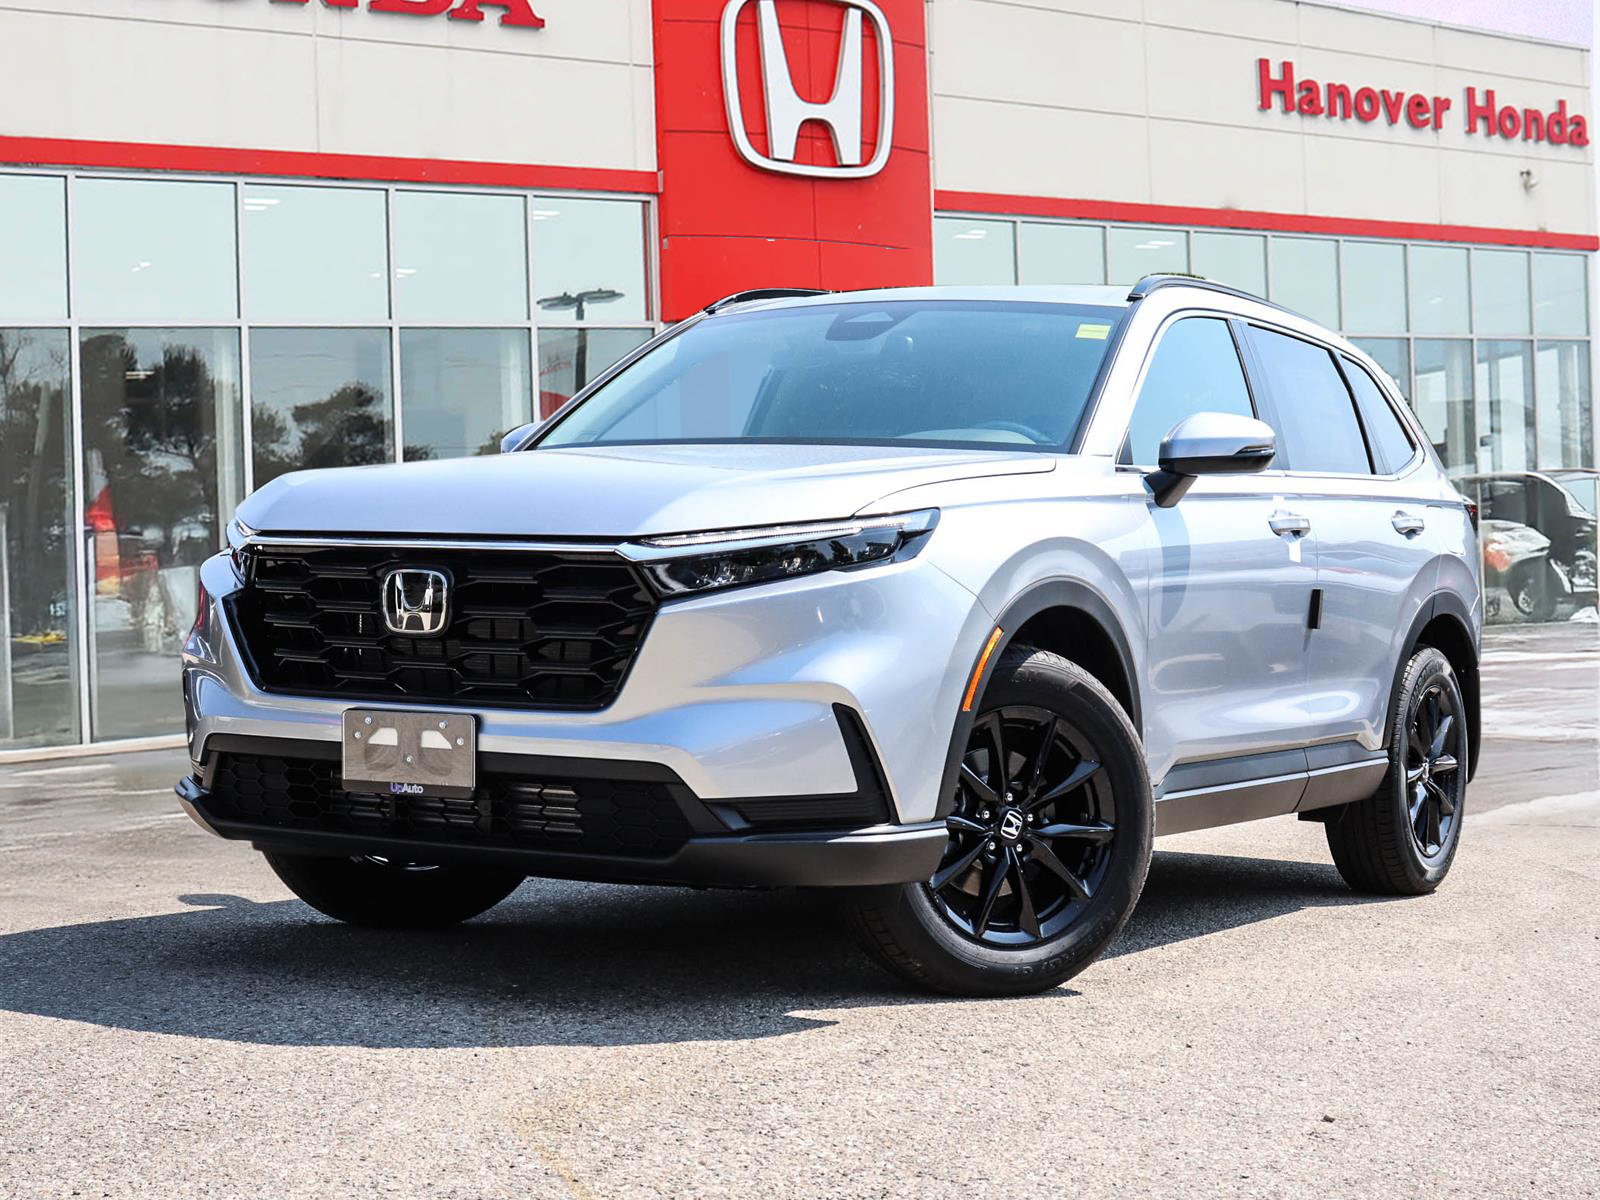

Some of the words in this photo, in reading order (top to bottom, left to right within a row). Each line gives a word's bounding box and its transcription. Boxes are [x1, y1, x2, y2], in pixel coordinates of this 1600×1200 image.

[1258, 57, 1453, 130] Hanover
[1465, 86, 1590, 147] Honda
[390, 782, 424, 795] UpAuto
